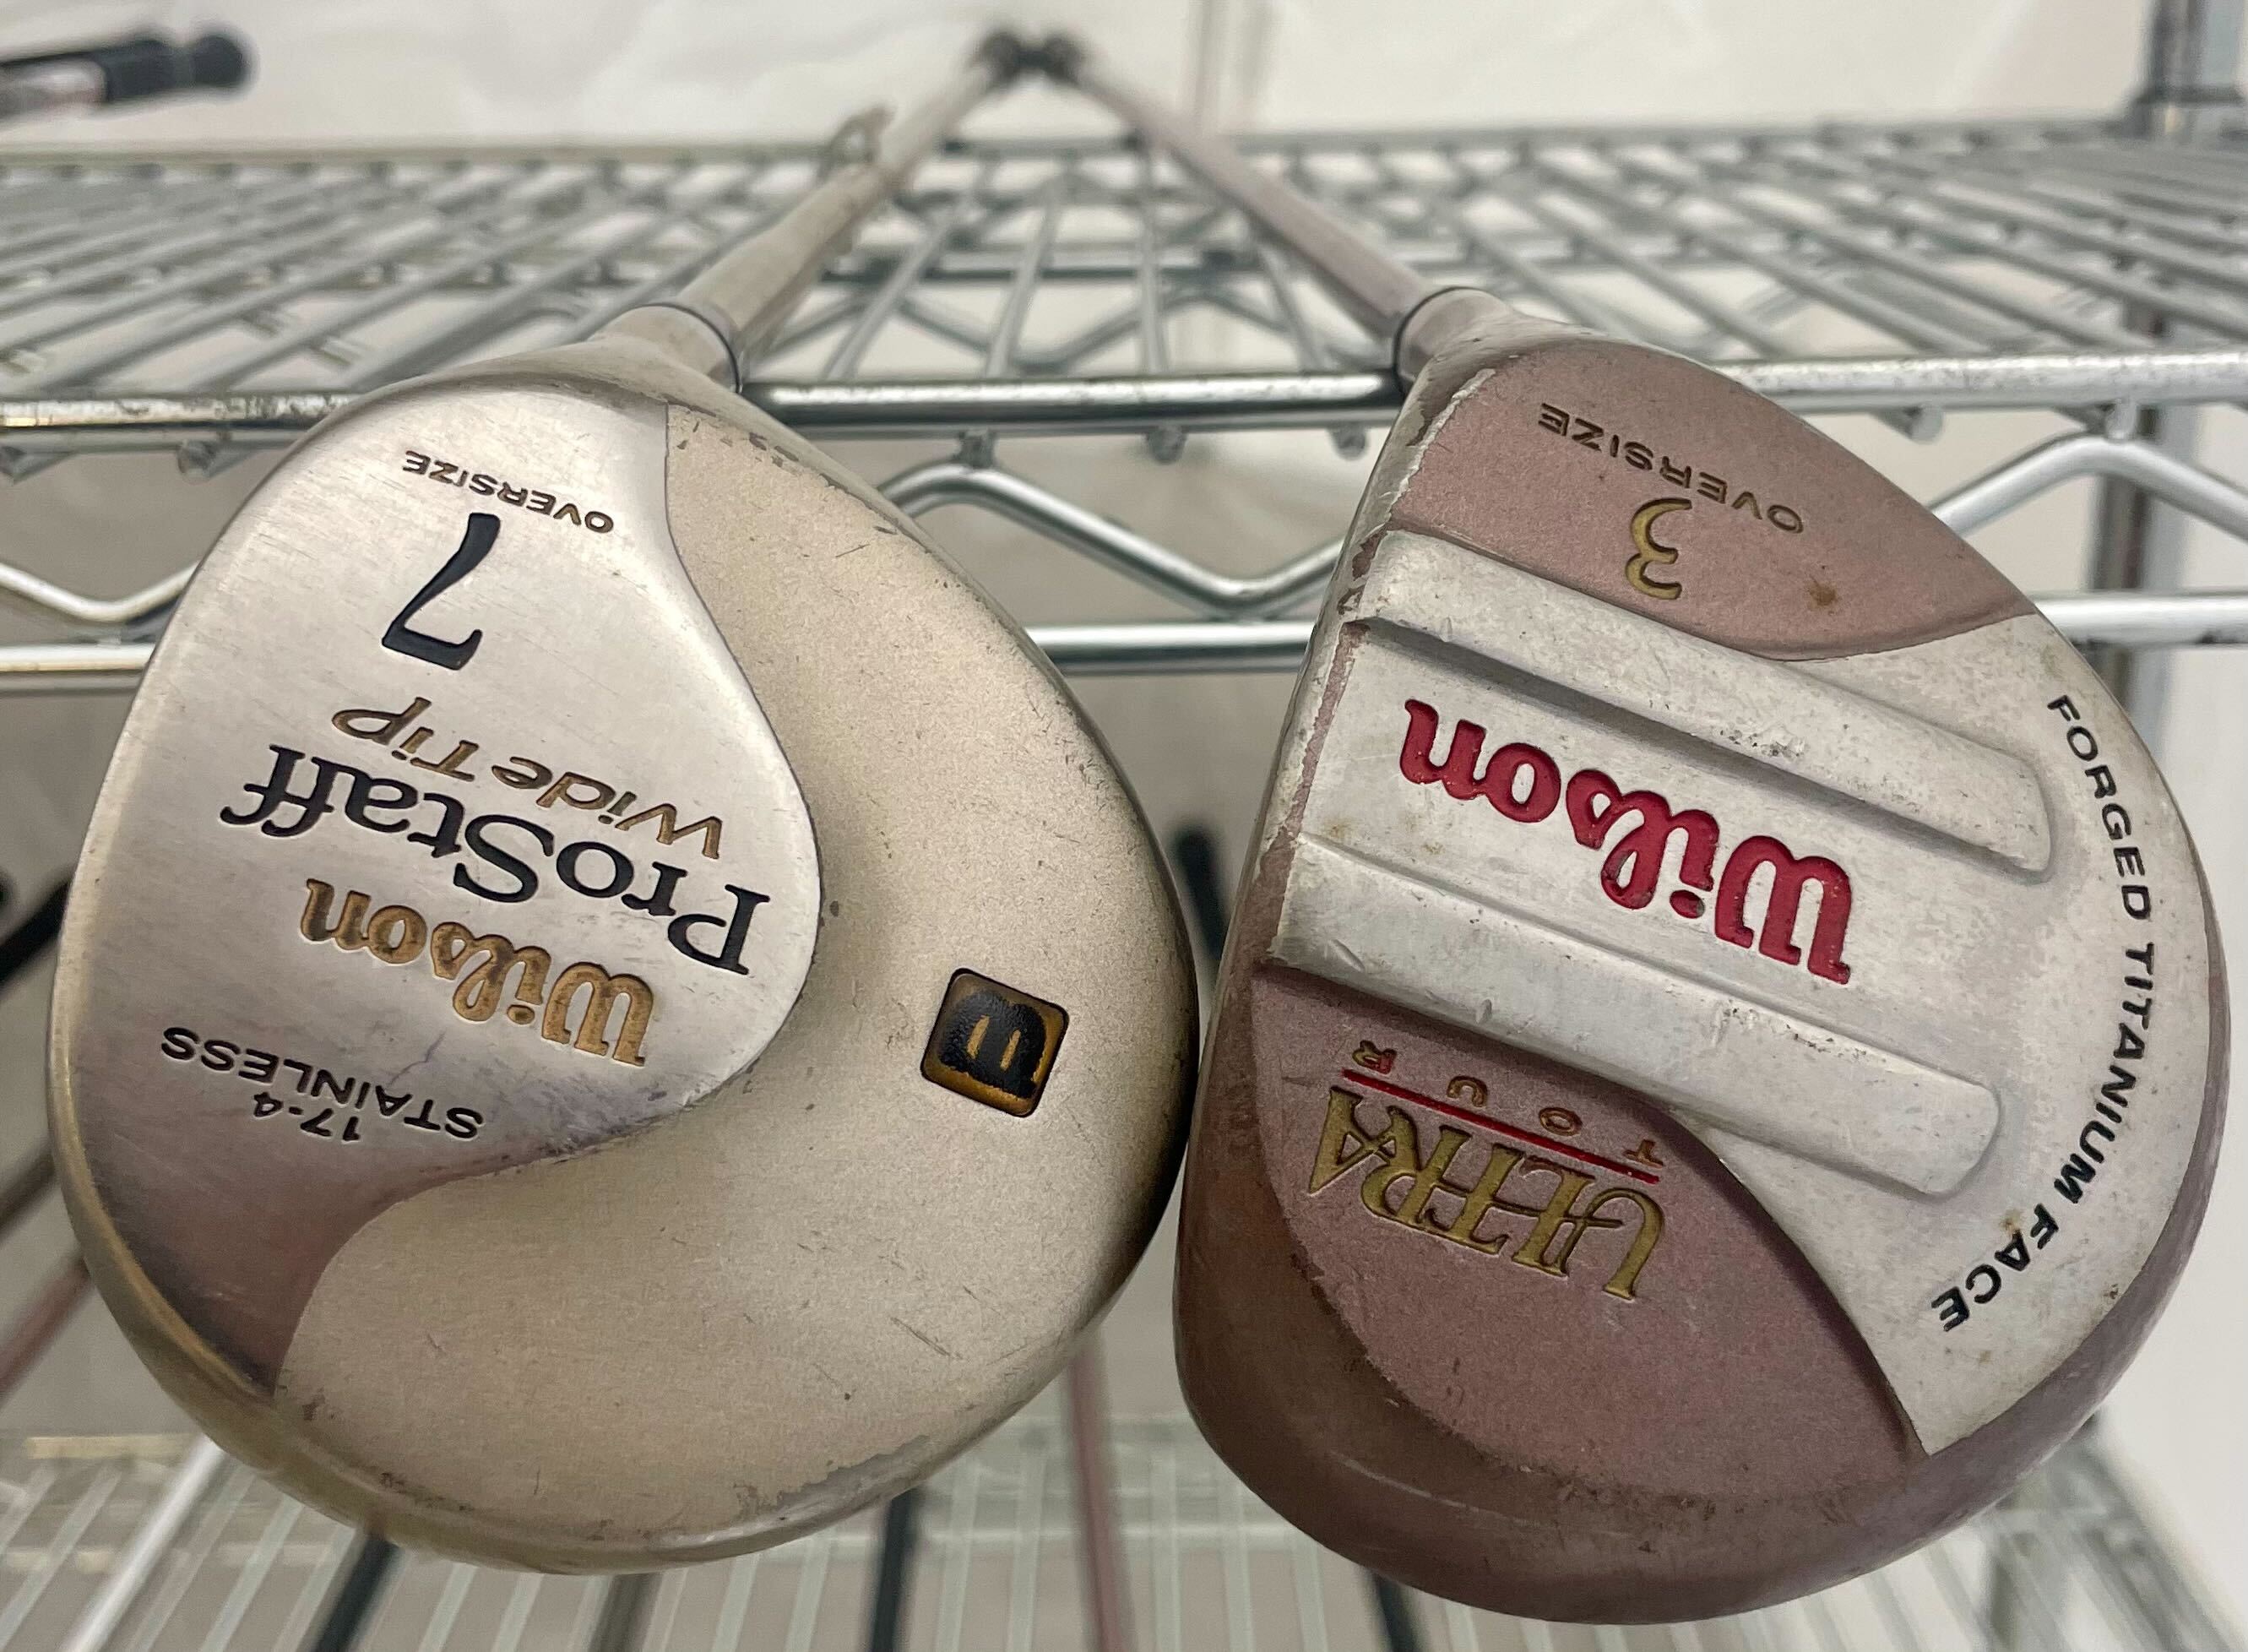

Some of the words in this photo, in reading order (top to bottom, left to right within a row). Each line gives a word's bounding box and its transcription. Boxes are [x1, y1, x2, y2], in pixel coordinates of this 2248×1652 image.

[401, 450, 615, 535] OVERSIZE
[1538, 403, 1804, 534] OVERSIZE
[382, 512, 501, 671] 7
[1625, 497, 1692, 600] 3
[220, 743, 770, 975] ProStaff
[491, 756, 723, 859] Wide
[1399, 698, 1853, 985] Wilson
[2047, 694, 2150, 921] FORGED
[298, 878, 654, 1067] Wilson
[161, 1025, 485, 1138] STAINLESS
[252, 1092, 361, 1143] 17-4
[2055, 943, 2155, 1204] TITANIUM
[1308, 1085, 1665, 1301] ULTRA
[1931, 1203, 2061, 1332] FACE
